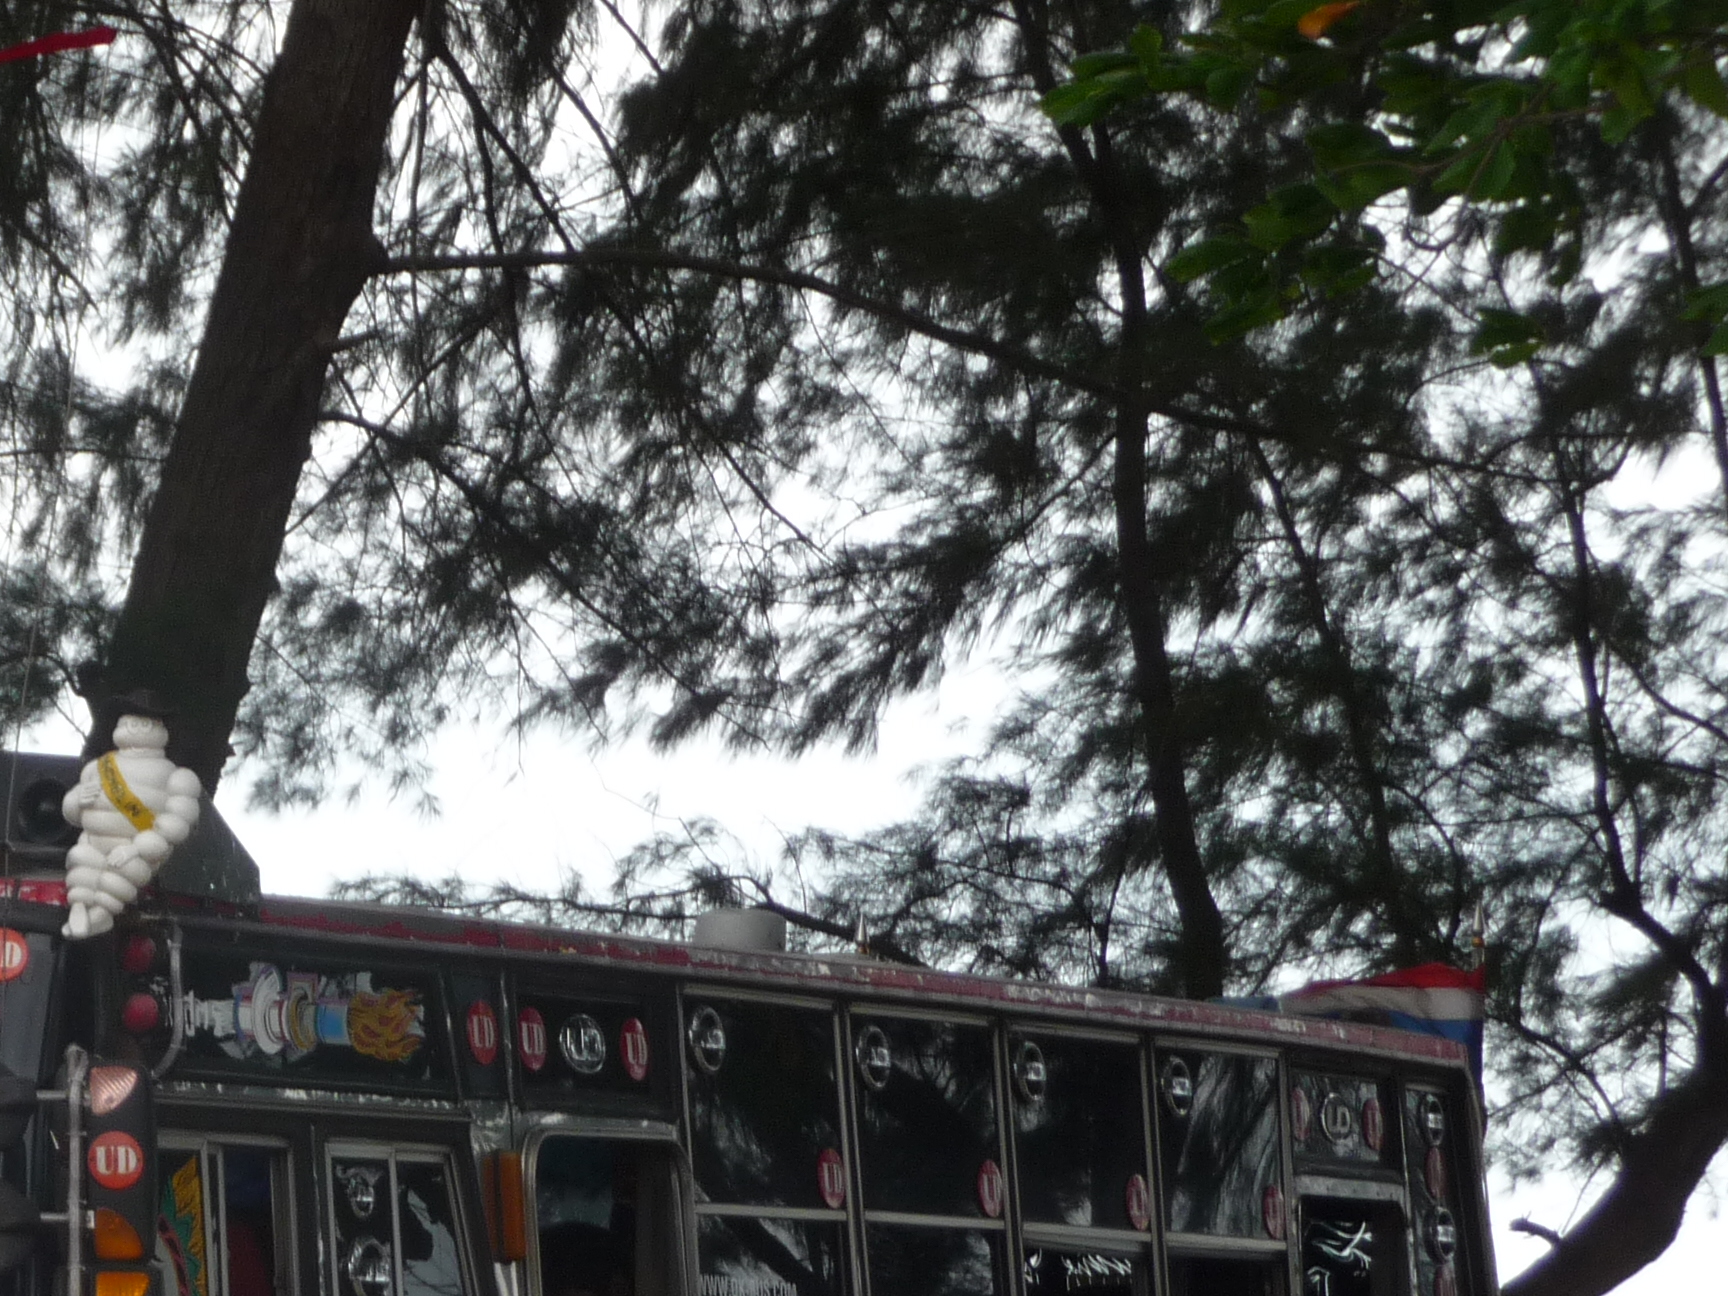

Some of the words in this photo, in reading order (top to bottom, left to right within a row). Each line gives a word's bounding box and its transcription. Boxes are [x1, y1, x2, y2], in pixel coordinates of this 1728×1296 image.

[472, 1015, 494, 1048] UD
[522, 1022, 544, 1054] UD
[626, 1032, 647, 1065] UD
[95, 1146, 137, 1174] UD
